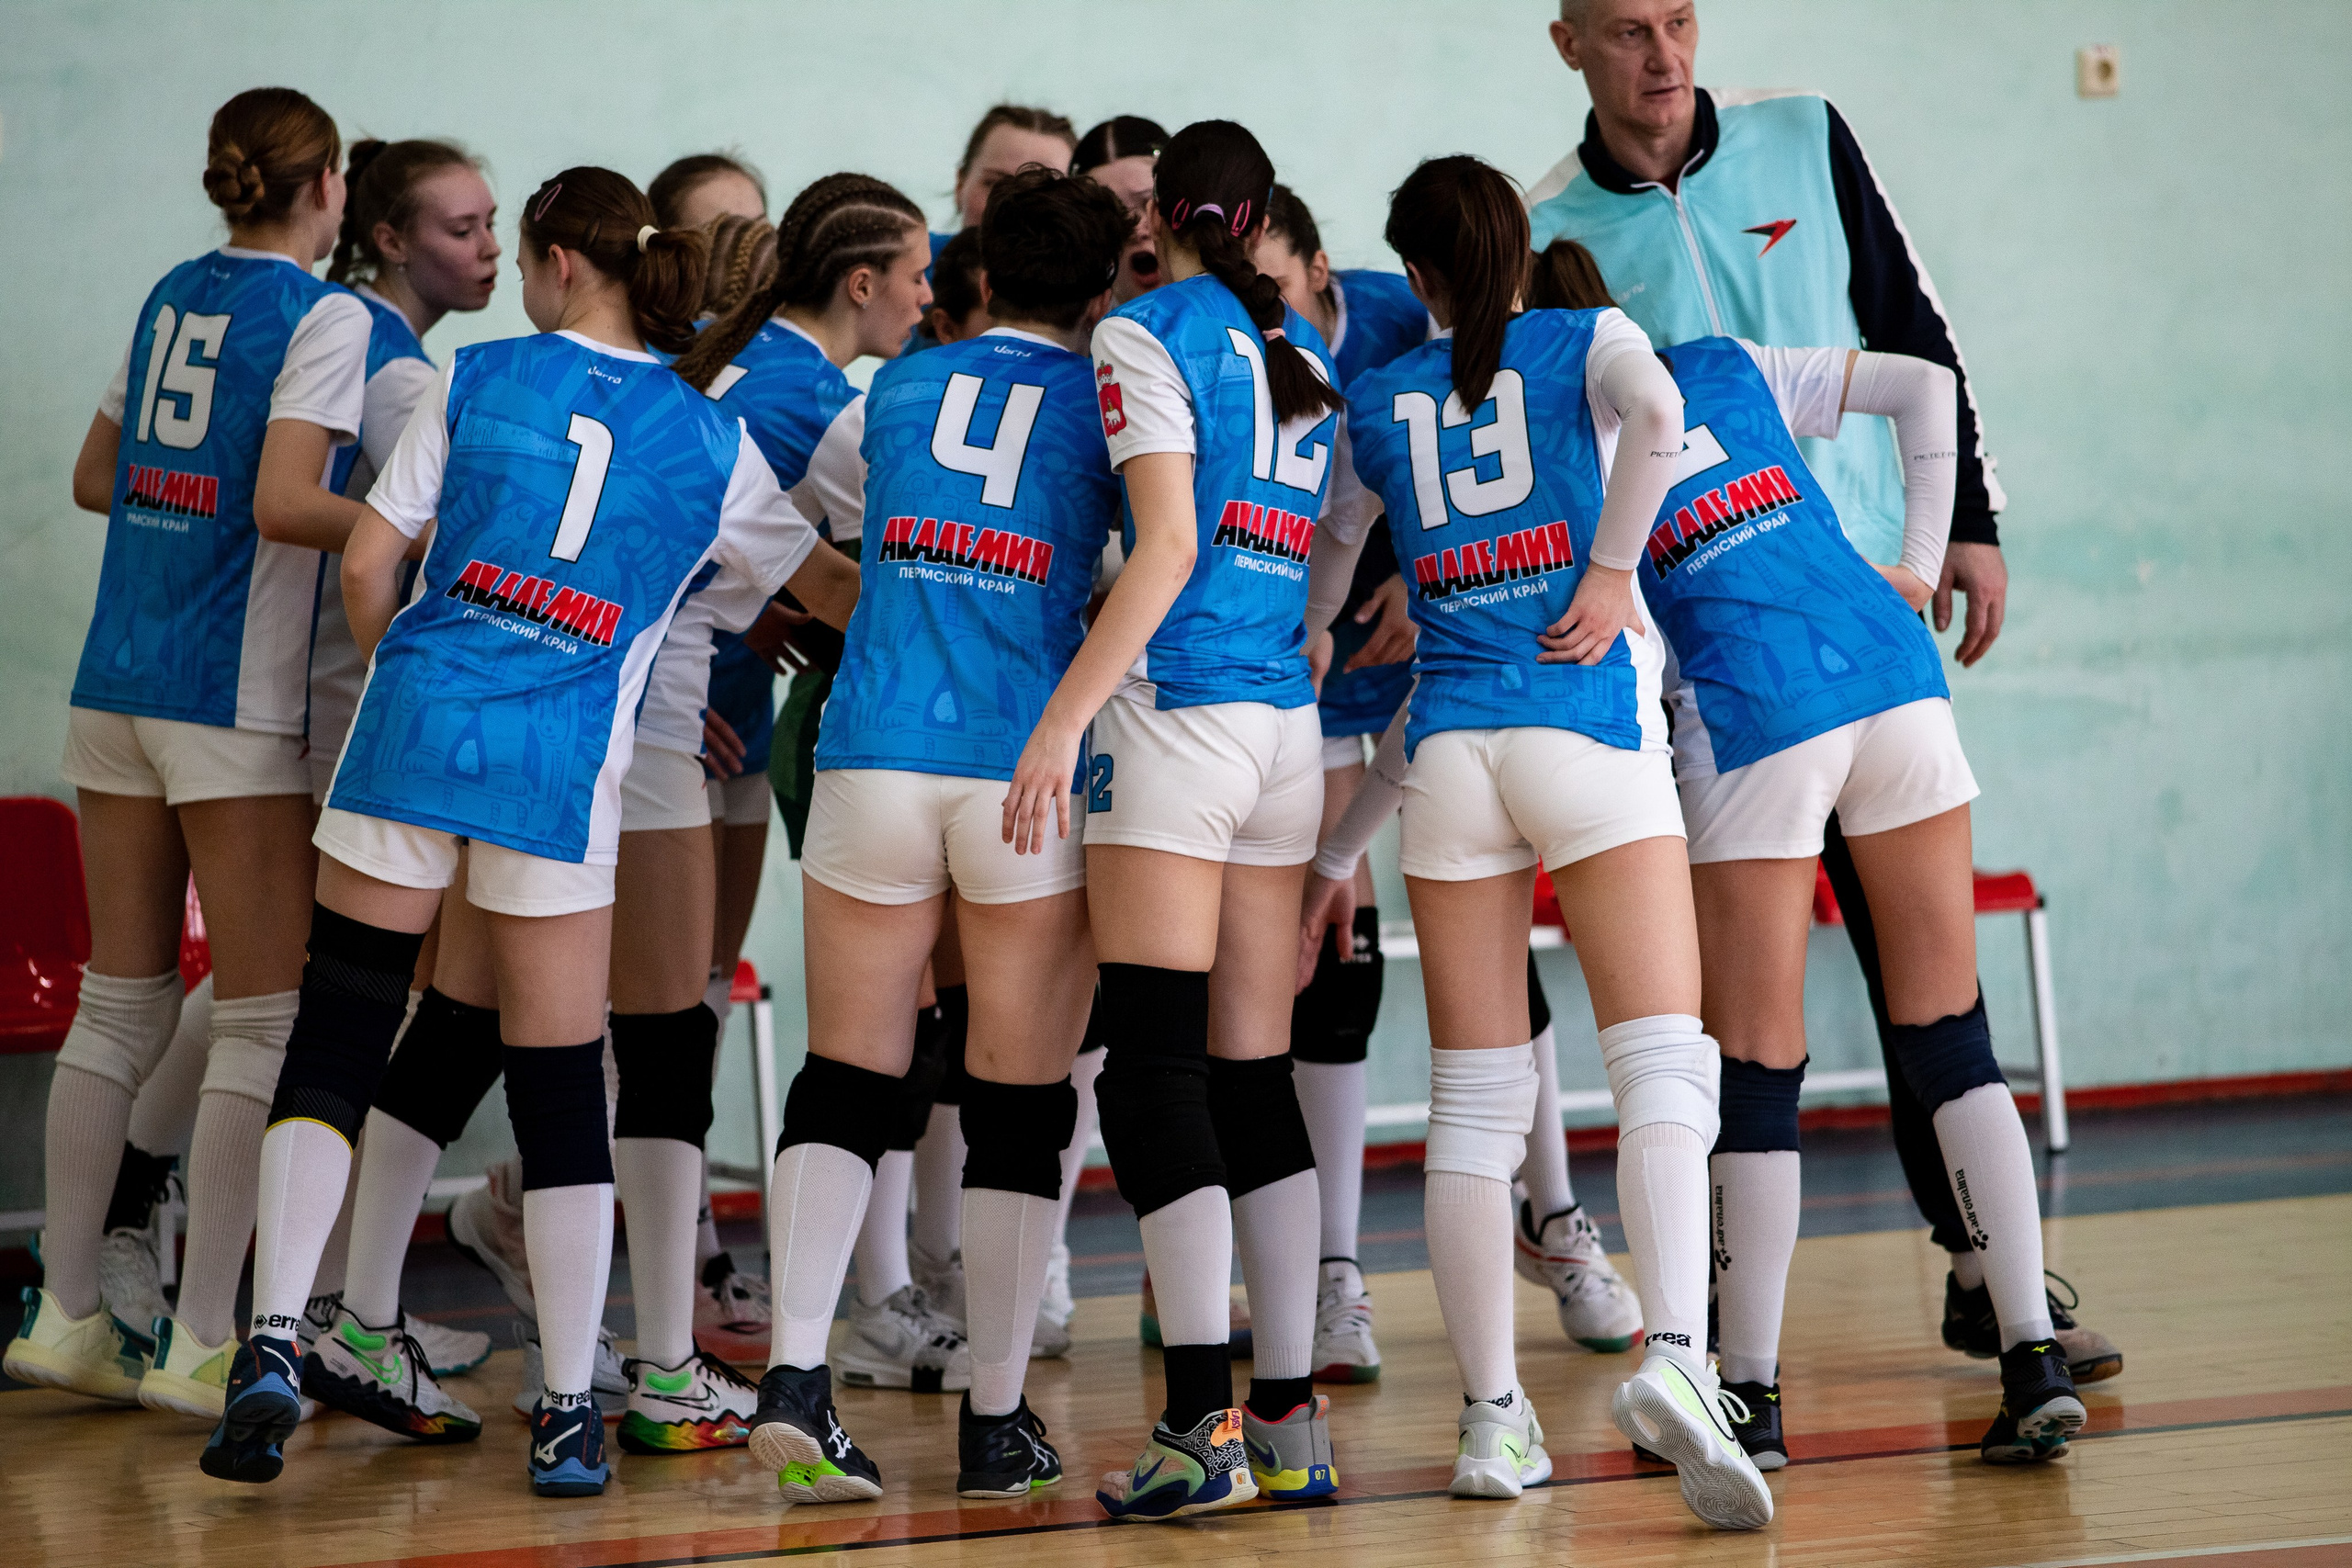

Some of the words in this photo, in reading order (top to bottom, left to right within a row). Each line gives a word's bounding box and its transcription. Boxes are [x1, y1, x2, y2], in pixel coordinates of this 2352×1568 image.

[137, 303, 232, 450] 15
[1226, 326, 1330, 497] 12
[930, 371, 1046, 510] 4
[1393, 368, 1535, 531] 13
[549, 412, 615, 563] 1
[1646, 466, 1804, 582] АКАДЕМИЯ
[877, 516, 1055, 587] АКАДЕМИЯ
[899, 567, 973, 586] ПЕРМСКИЙ
[978, 578, 1015, 594] КРАЙ
[1234, 554, 1288, 576] ПЕРМСКИЙ
[1414, 520, 1575, 603] АКАДЕМИЯ
[1686, 525, 1758, 575] ПЕРМСКИЙ
[1757, 511, 1791, 535] КРАЙ
[445, 559, 624, 649] АКАДЕМИЯ
[462, 608, 540, 641] ПЕРМСКИЙ
[542, 631, 579, 655] КРАЙ
[1440, 586, 1510, 614] ПЕРМСКИЙ
[1513, 578, 1549, 598] КРАЙ
[1955, 1168, 1980, 1229] adrenalina
